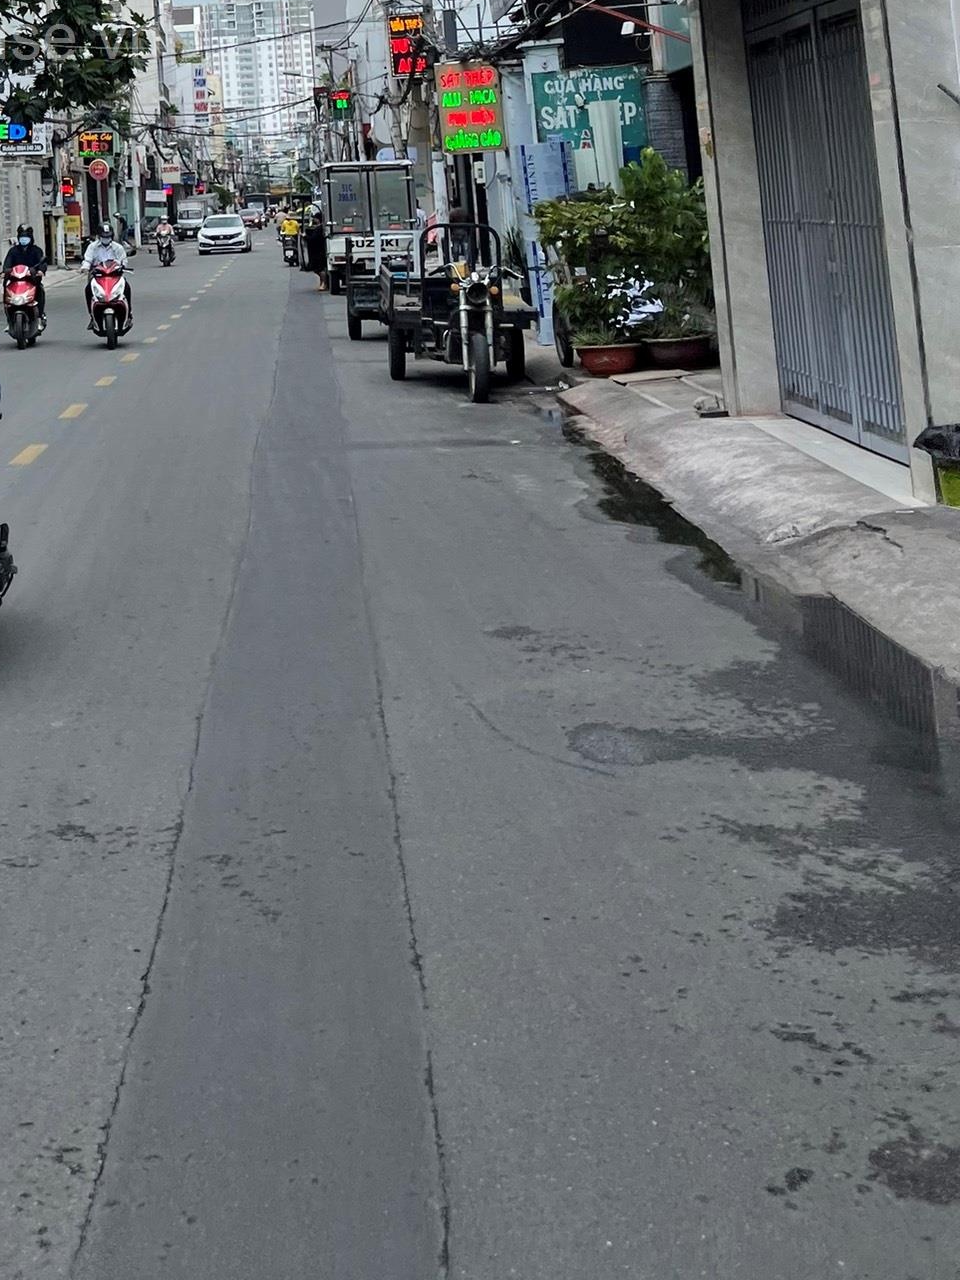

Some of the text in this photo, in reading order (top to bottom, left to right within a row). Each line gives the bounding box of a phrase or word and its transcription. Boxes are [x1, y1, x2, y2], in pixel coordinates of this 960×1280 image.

[580, 73, 625, 92] HÀNG
[584, 96, 637, 128] TP
[83, 141, 109, 152] LED
